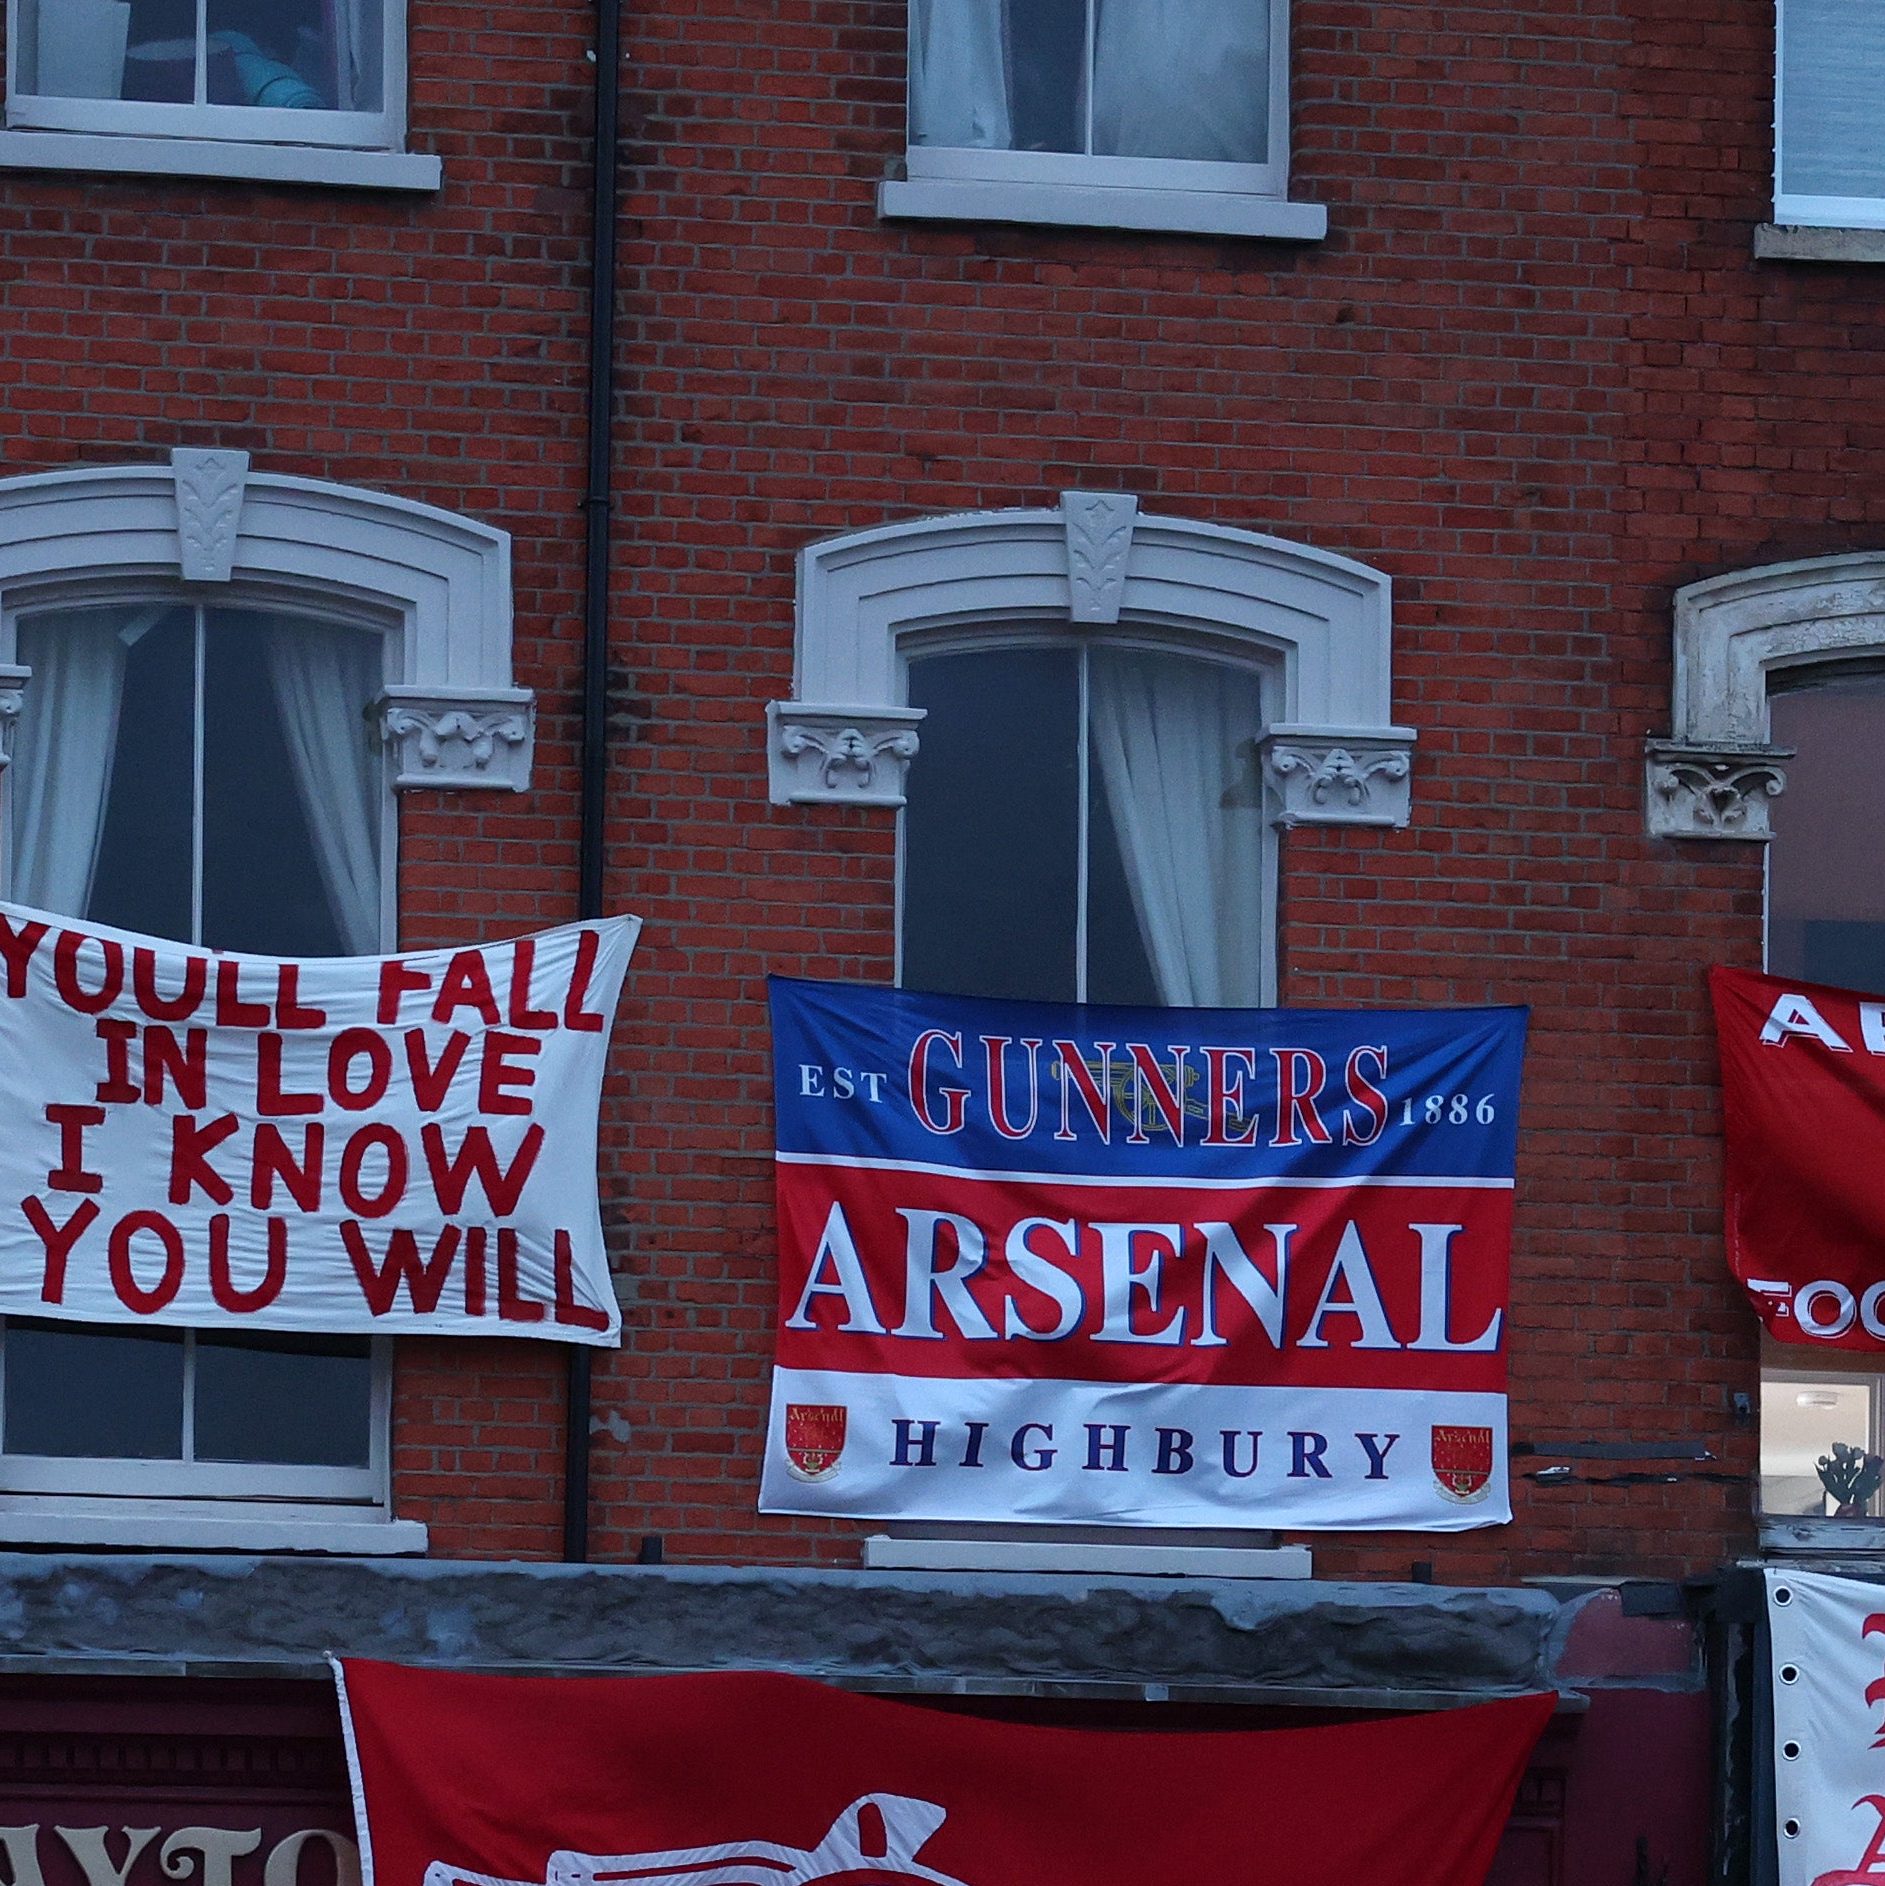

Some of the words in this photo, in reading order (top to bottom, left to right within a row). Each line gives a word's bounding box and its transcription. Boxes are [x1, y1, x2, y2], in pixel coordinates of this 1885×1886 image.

[377, 929, 604, 1032] FALL
[96, 1019, 208, 1110] IN
[256, 1027, 543, 1115] LOVE
[798, 1064, 888, 1104] EST
[907, 1029, 1390, 1149] GUNNERS
[1399, 1093, 1495, 1127] 1886
[45, 1104, 105, 1193] I
[168, 1113, 545, 1219] KNOW
[21, 1195, 287, 1314] YOU
[340, 1219, 610, 1333] WILL
[784, 1201, 1503, 1354] ARSENAL
[889, 1418, 1400, 1481] HIGHBURY
